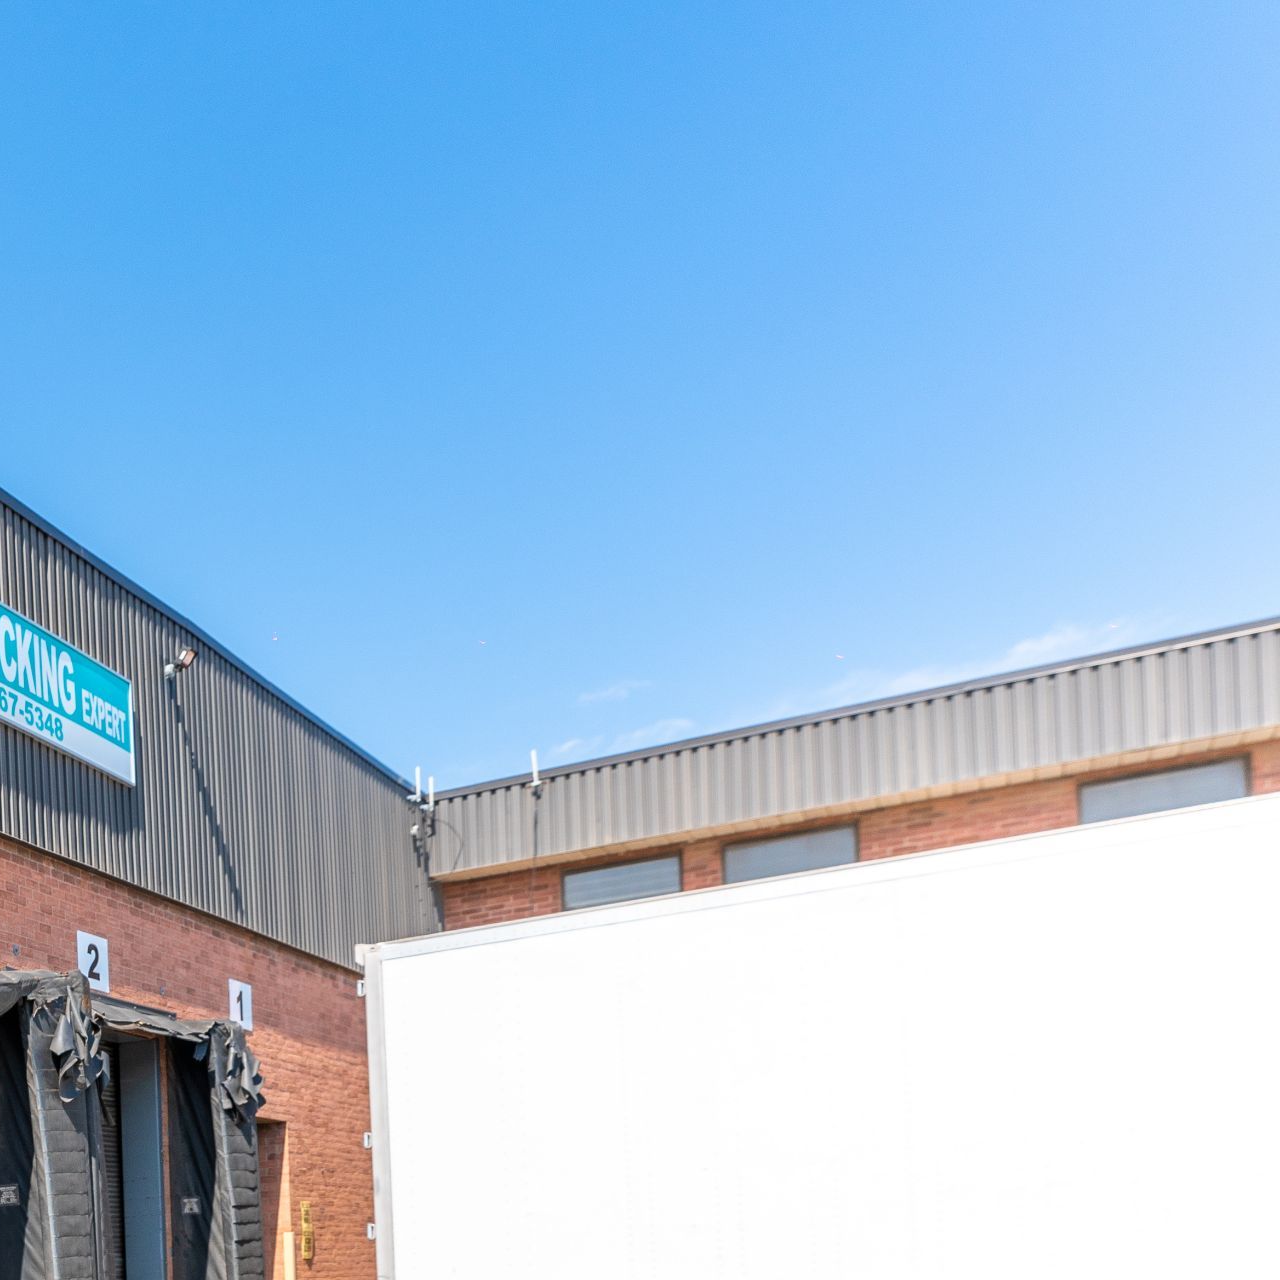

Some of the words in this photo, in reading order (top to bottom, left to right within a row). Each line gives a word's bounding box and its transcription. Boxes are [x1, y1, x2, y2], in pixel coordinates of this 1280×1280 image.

[81, 688, 126, 743] EXPERT
[86, 943, 101, 981] 2
[237, 991, 244, 1021] 1
